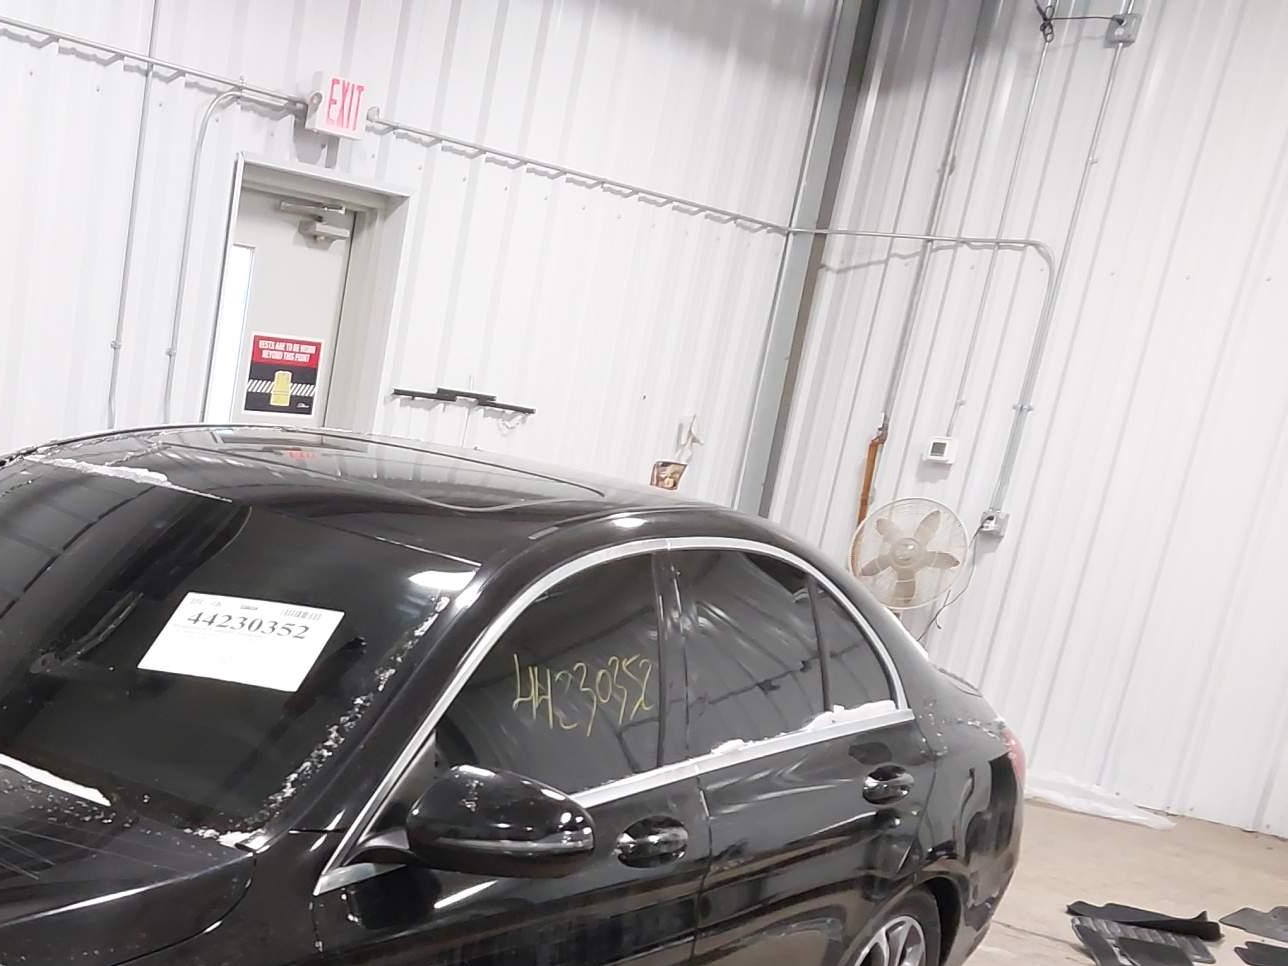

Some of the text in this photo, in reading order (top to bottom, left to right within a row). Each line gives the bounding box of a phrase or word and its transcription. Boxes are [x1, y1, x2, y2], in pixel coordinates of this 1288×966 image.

[326, 78, 365, 131] EXIT
[284, 351, 295, 360] THIS
[286, 342, 293, 351] TO
[187, 611, 310, 640] 44230352
[512, 653, 655, 737] 44230352
